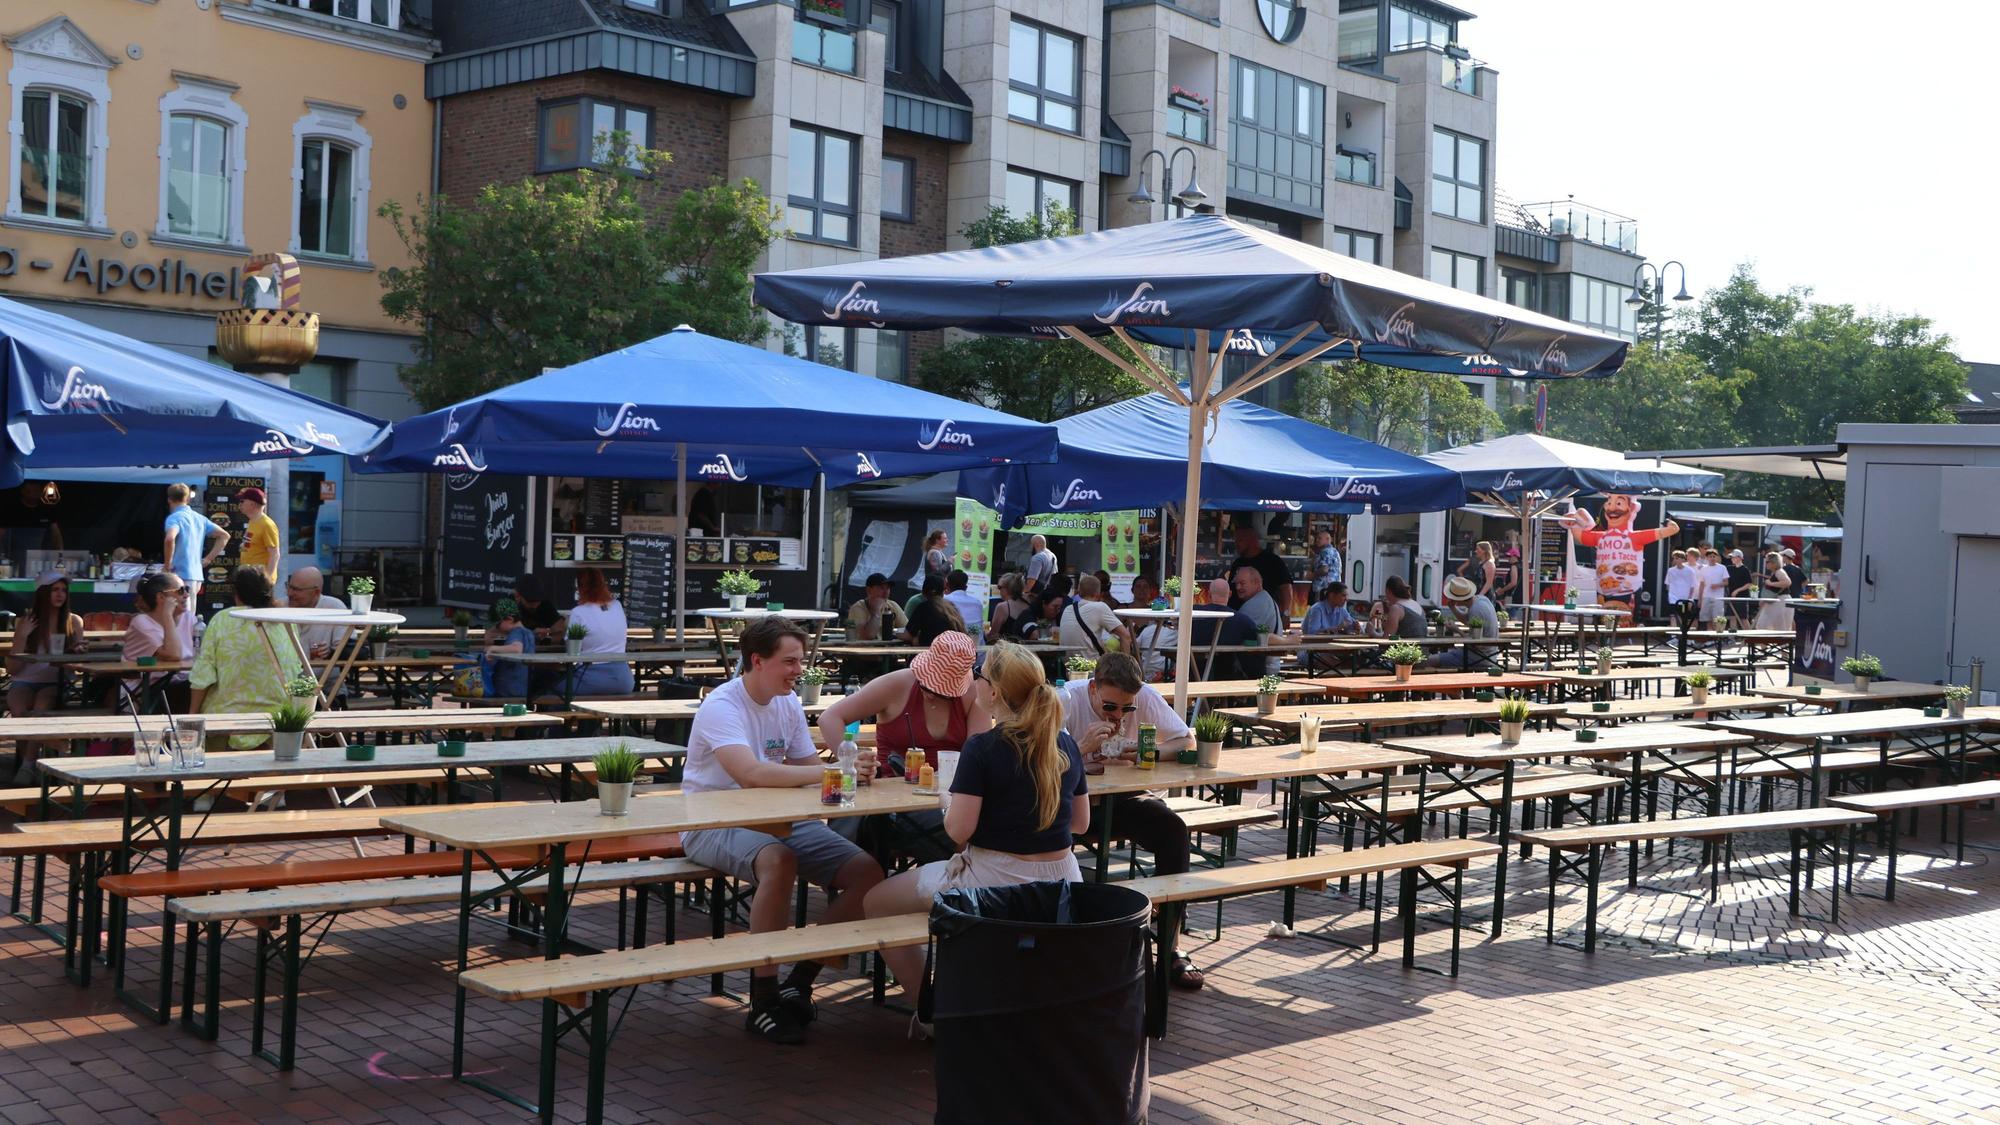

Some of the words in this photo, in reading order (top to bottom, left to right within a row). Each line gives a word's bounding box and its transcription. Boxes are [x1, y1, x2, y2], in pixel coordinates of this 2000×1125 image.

[40, 366, 112, 410] Sion
[594, 402, 661, 437] Sion
[917, 419, 975, 450] Sion
[209, 478, 221, 486] AL
[226, 478, 263, 487] PACINO
[1049, 478, 1102, 509] Sion
[1050, 518, 1078, 529] Street
